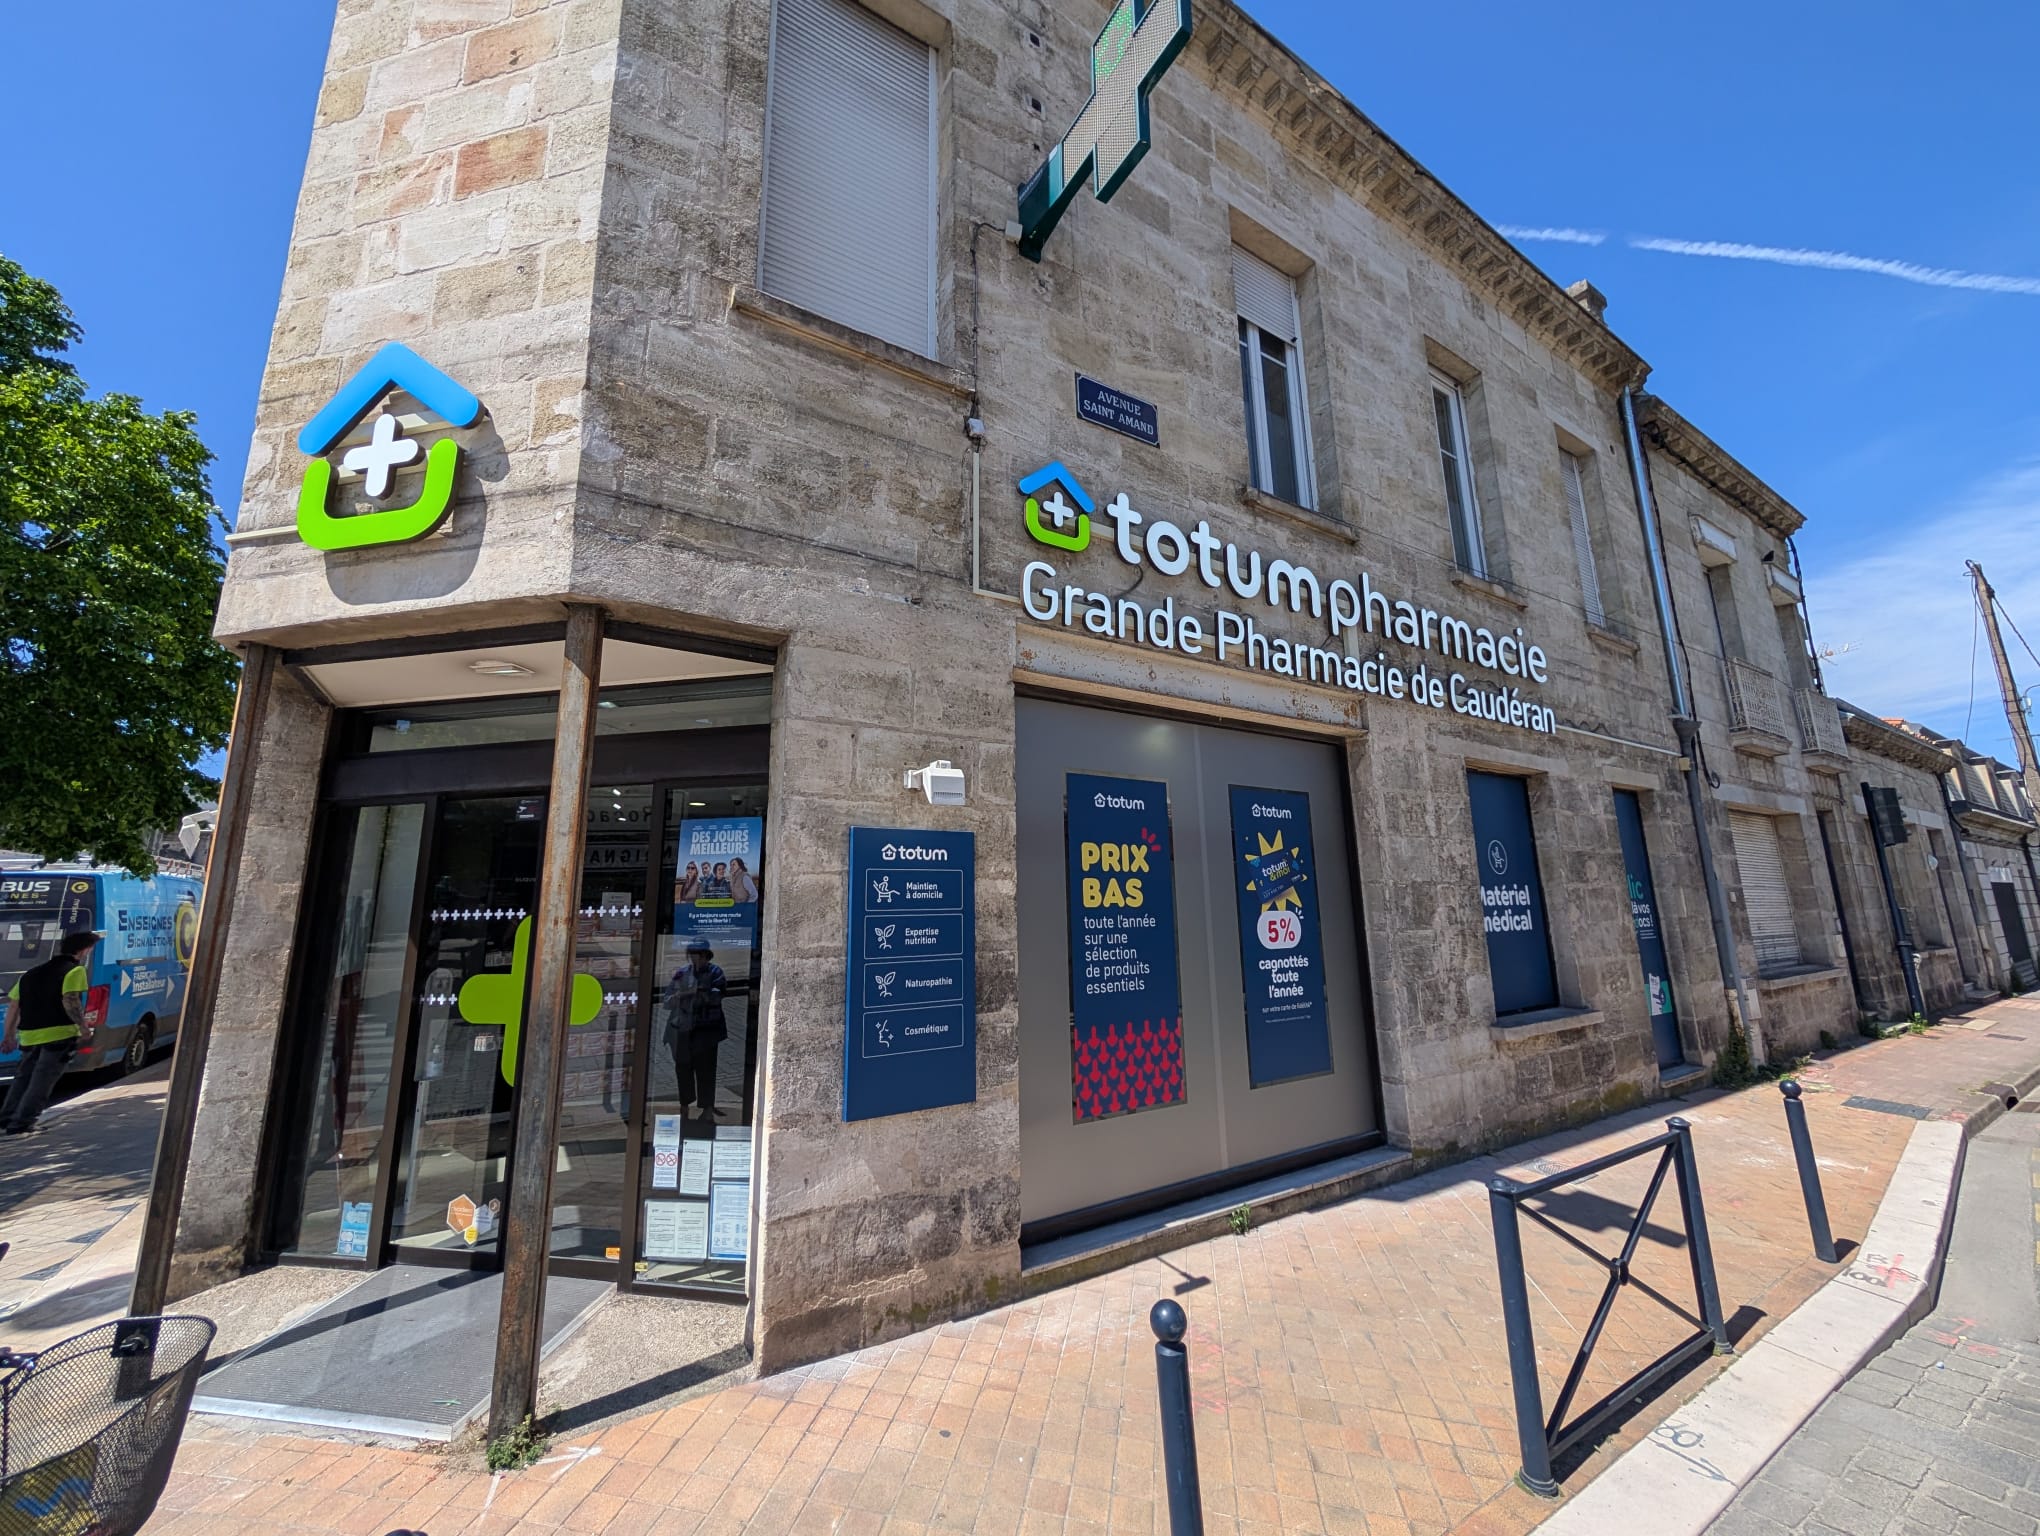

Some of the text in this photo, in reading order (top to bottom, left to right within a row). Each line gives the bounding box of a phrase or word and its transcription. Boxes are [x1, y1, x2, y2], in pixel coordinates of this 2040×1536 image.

[1097, 390, 1141, 416] AVENUE
[1083, 399, 1154, 435] SAINT AMAND
[1106, 491, 1548, 685] totum pharmacie
[1020, 560, 1556, 734] Grande Pharmacie de Caudéran
[1106, 794, 1145, 811] totum
[1261, 804, 1292, 820] totum
[691, 829, 749, 844] DES JOURS
[689, 841, 750, 856] MEILLEURS
[898, 845, 948, 861] totum
[1080, 841, 1149, 873] PRIX
[905, 881, 938, 891] Maintien
[1081, 877, 1144, 909] BAS
[905, 889, 943, 900] à domicile
[118, 909, 173, 931] ENSEIGNES
[1083, 914, 1156, 930] toute l'année
[904, 927, 940, 938] Expertise
[1267, 917, 1296, 943] 5%
[904, 936, 937, 945] nutrition
[1084, 931, 1128, 946] sur une
[1084, 947, 1138, 962] sélection
[1085, 961, 1151, 980] de produits
[1258, 955, 1309, 972] cagnottés
[905, 976, 953, 989] Naturopathie
[1271, 969, 1300, 984] toute
[1086, 977, 1146, 995] essentiels
[1268, 983, 1304, 999] l'année
[904, 1023, 949, 1036] Cosmétique
